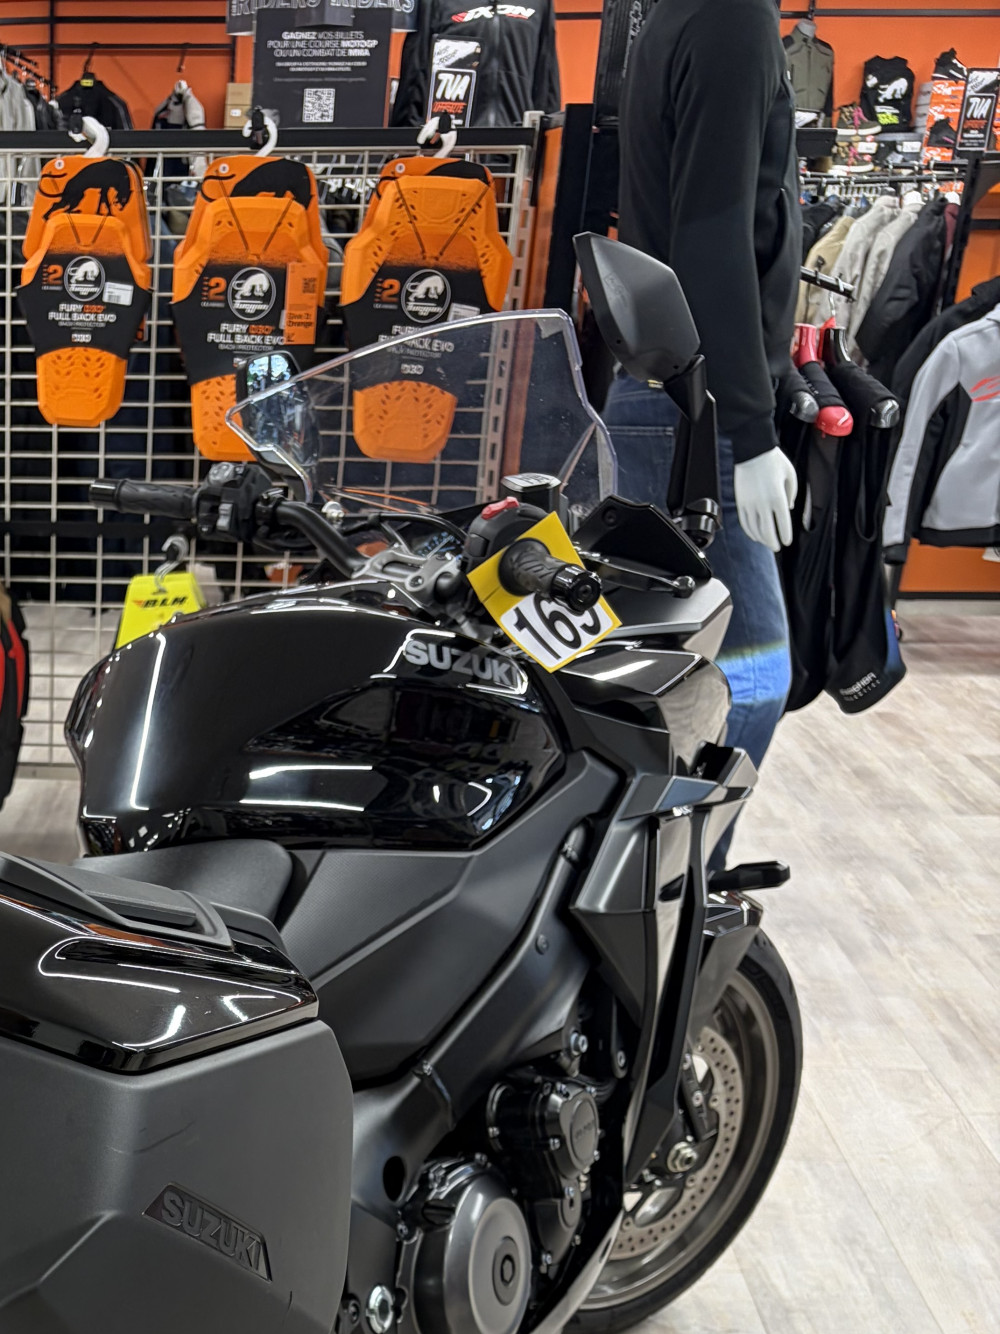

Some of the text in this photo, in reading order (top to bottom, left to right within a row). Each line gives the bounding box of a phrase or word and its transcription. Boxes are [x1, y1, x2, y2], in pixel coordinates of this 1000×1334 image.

[309, 40, 340, 48] COURSE
[341, 40, 378, 48] MOTOGP
[302, 48, 335, 57] COMBAT
[435, 72, 471, 101] TVA
[966, 97, 992, 119] TVA
[48, 312, 72, 321] FULL
[72, 312, 96, 321] BACK
[220, 323, 249, 334] FURY
[207, 333, 234, 343] FULL
[234, 333, 264, 344] BACK
[404, 639, 518, 687] SUZUKI
[161, 1189, 262, 1271] SUZUKI
